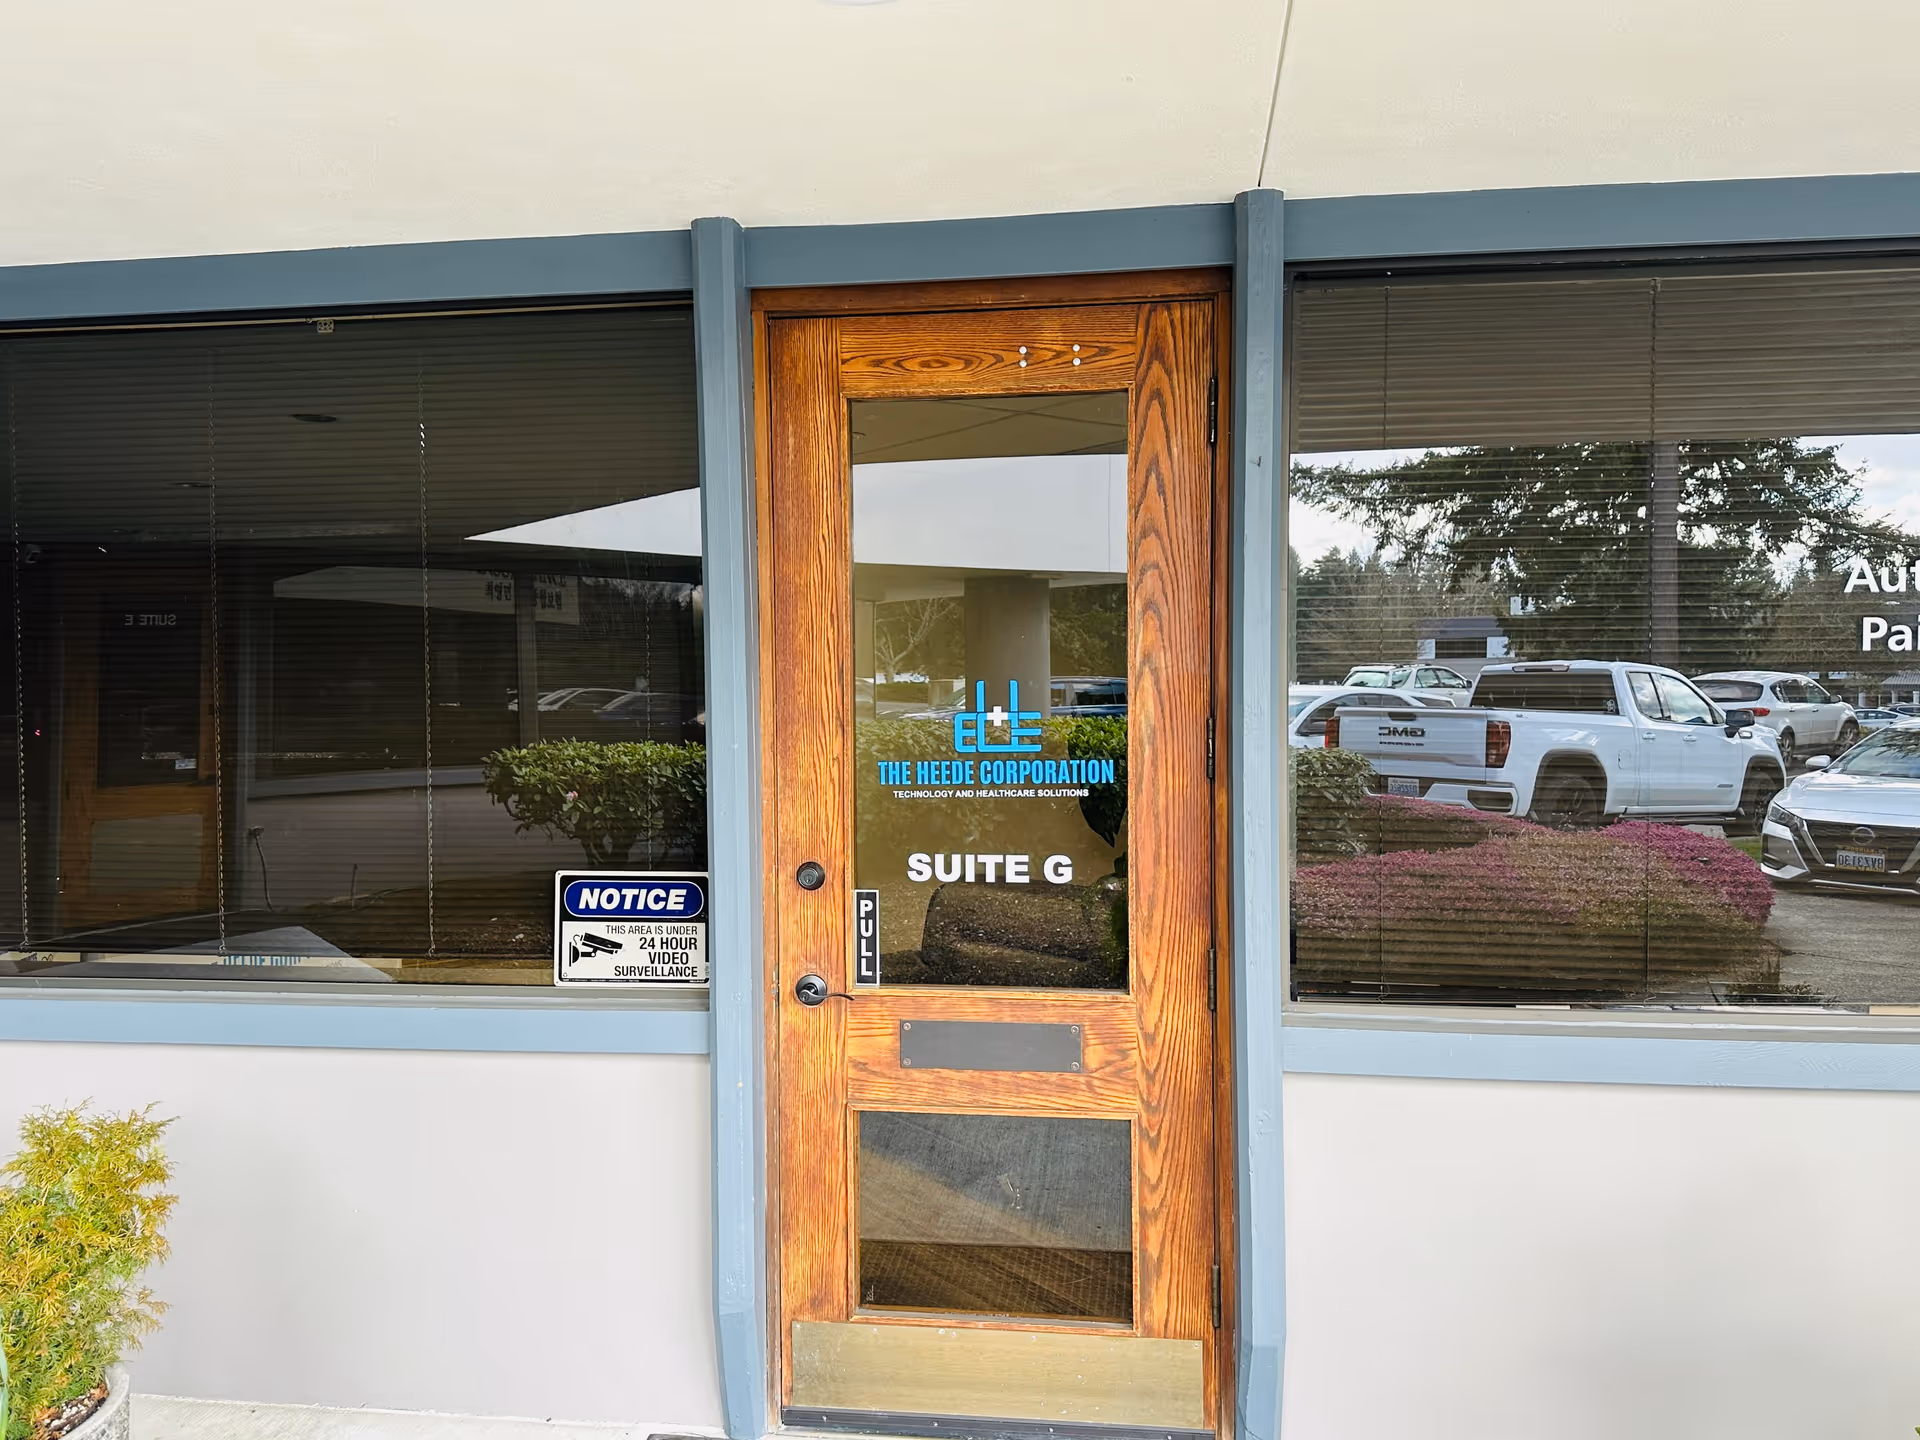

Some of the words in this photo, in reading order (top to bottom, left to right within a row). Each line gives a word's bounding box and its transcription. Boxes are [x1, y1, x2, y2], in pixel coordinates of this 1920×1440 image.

[877, 760, 911, 785] THE
[916, 760, 974, 785] HEEDE
[979, 758, 1115, 785] CORPORATION
[893, 789, 954, 798] TECHNOLOGY
[955, 789, 974, 798] AND
[976, 788, 1036, 798] HEALTHCARE
[1037, 788, 1089, 797] SOLUTIONS
[906, 853, 1030, 883] SUITE
[1043, 854, 1073, 884] G
[578, 887, 688, 911] NOTICE
[605, 925, 626, 935] THIS
[628, 925, 653, 935] AREA
[655, 925, 663, 935] IS
[666, 925, 698, 935] UNDER
[639, 937, 656, 950] 24
[660, 937, 698, 950] HOUR
[859, 899, 874, 977] PULL
[648, 951, 689, 965] VIDEO
[614, 966, 698, 978] SURVEILLANCE
